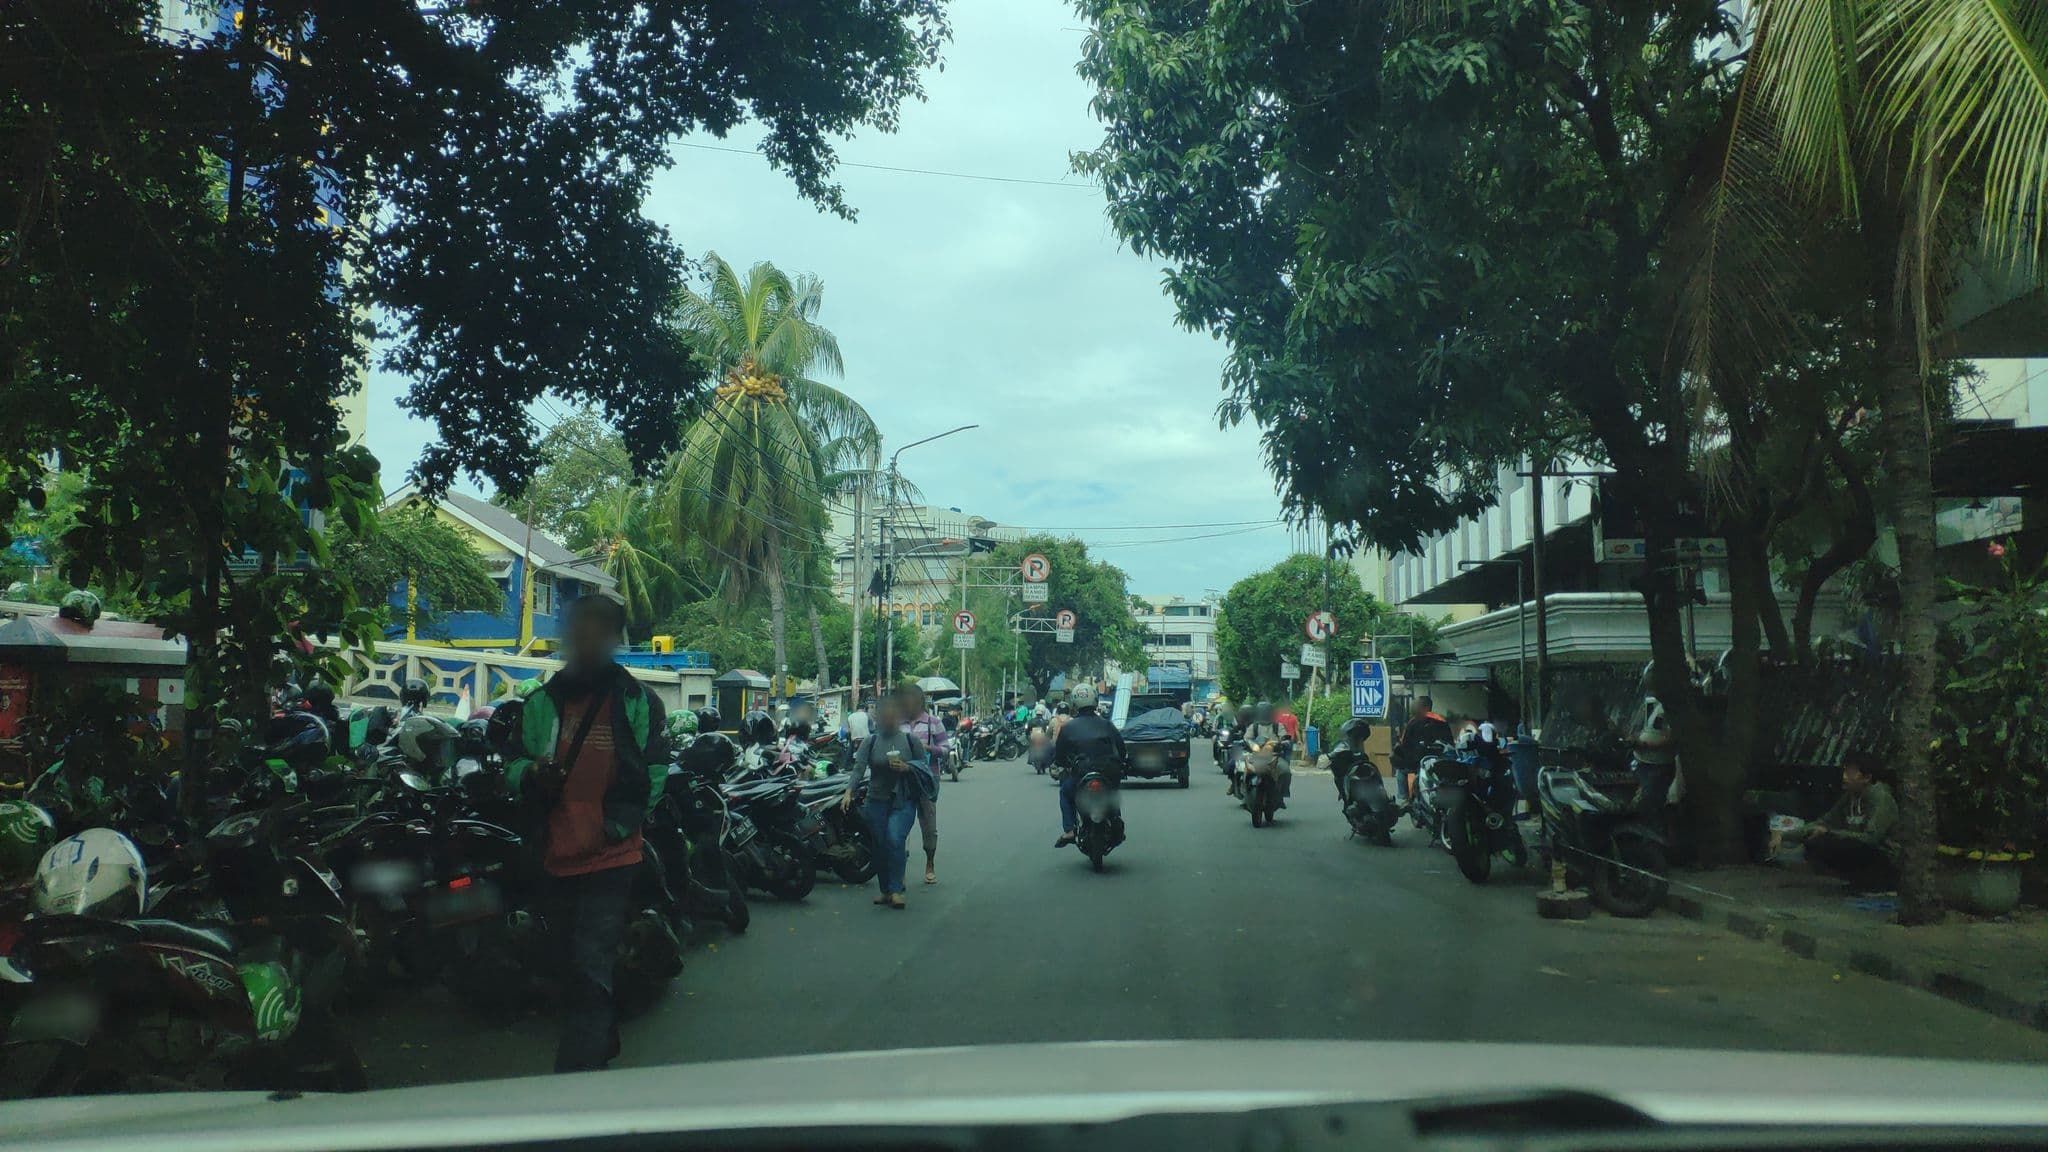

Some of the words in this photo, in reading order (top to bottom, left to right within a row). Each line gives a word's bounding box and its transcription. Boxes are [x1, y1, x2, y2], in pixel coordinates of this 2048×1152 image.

[1355, 679, 1381, 687] LOBBY
[1355, 687, 1373, 706] IN
[1355, 706, 1382, 714] MASUK
